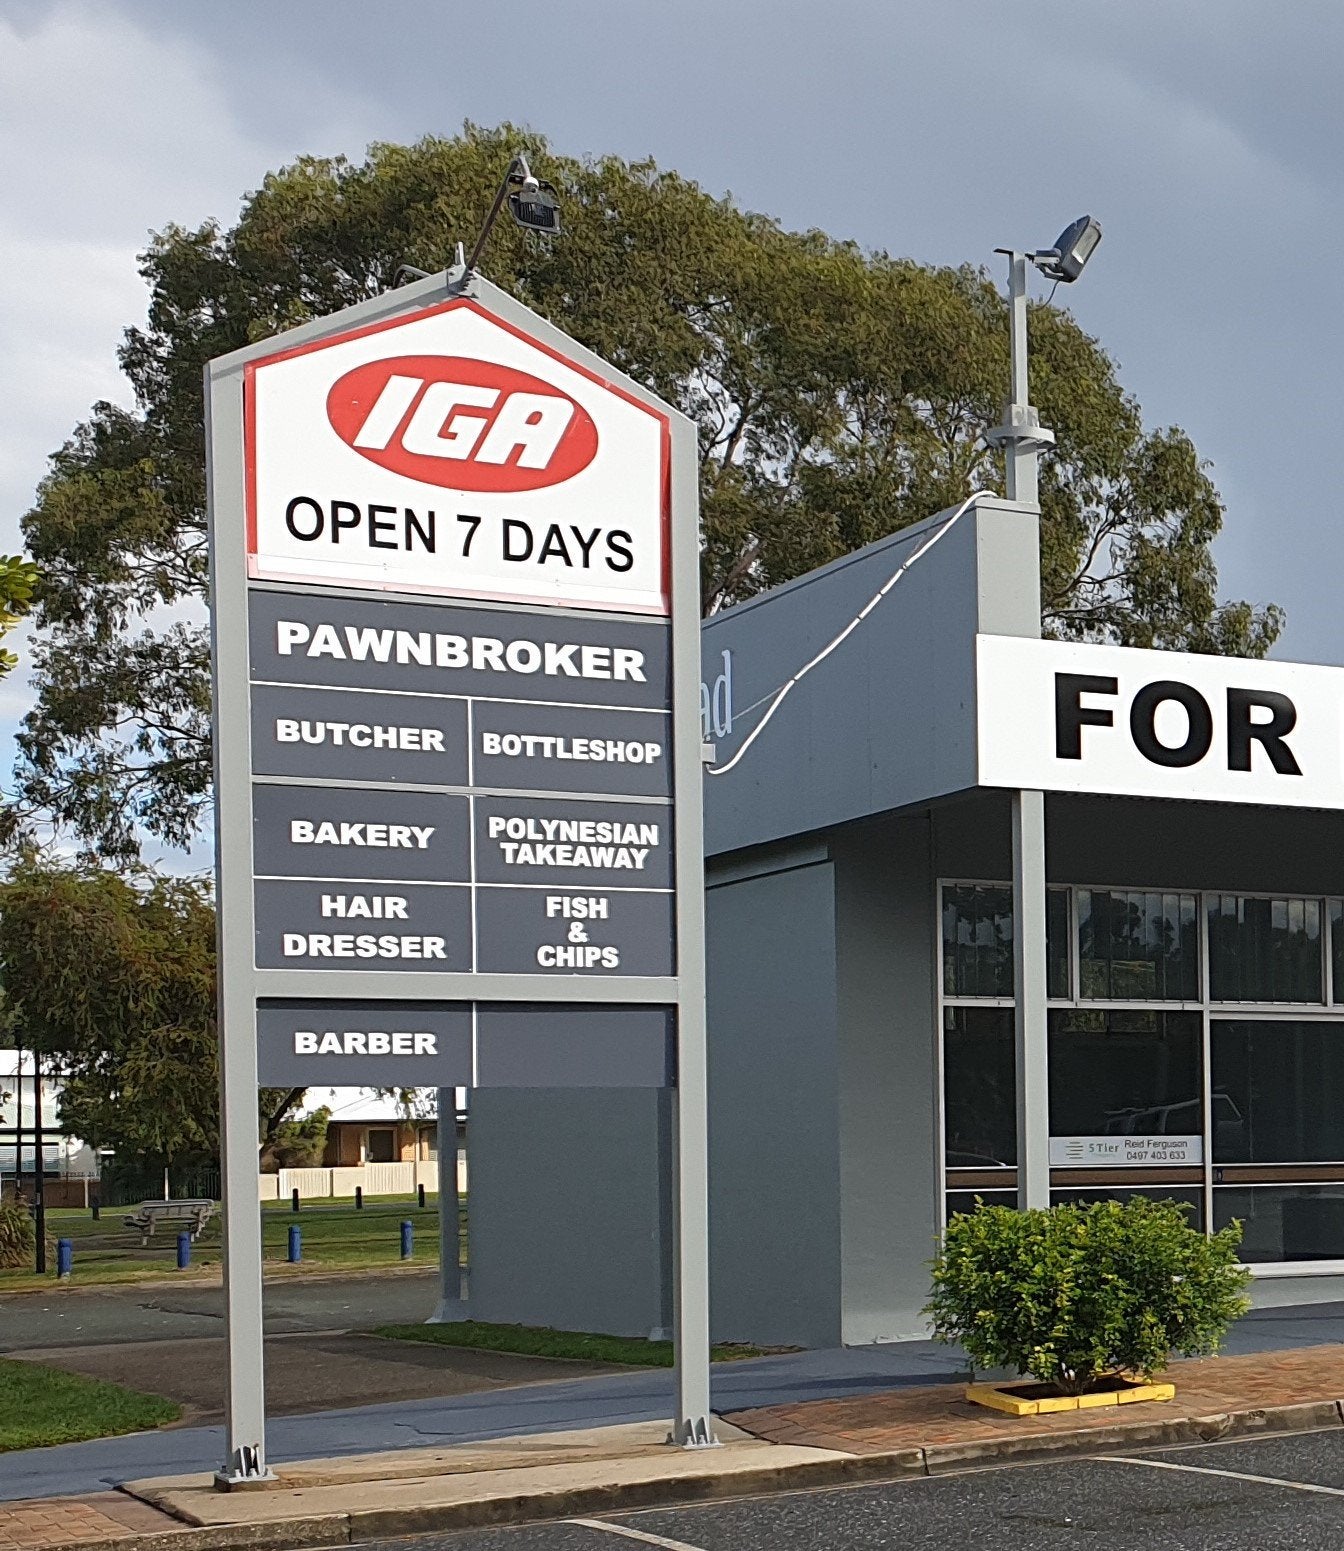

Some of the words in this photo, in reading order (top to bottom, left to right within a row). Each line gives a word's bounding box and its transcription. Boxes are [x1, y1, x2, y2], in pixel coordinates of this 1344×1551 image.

[353, 374, 574, 470] IGA
[285, 496, 436, 553] OPEN
[456, 515, 482, 557] 7
[502, 518, 634, 572] DAYS
[276, 621, 647, 682] PAWNBROKER
[276, 719, 446, 752] BUTCHER
[1054, 672, 1303, 777] FOR
[482, 732, 661, 764] BOTTLESHOP
[291, 820, 435, 849] BAKERY
[488, 816, 659, 846] POLYNESIAN
[500, 842, 649, 869] TAKEAWAY
[321, 894, 408, 920] HAIR
[546, 896, 608, 919] FISH
[283, 932, 447, 959] DRESSER
[567, 922, 588, 943] &
[536, 944, 619, 968] CHIPS
[294, 1032, 438, 1055] BARBER
[1088, 1143, 1094, 1152] 5
[1125, 1139, 1144, 1148] Reid
[1147, 1139, 1187, 1150] Ferguson
[1150, 1151, 1167, 1160] 403
